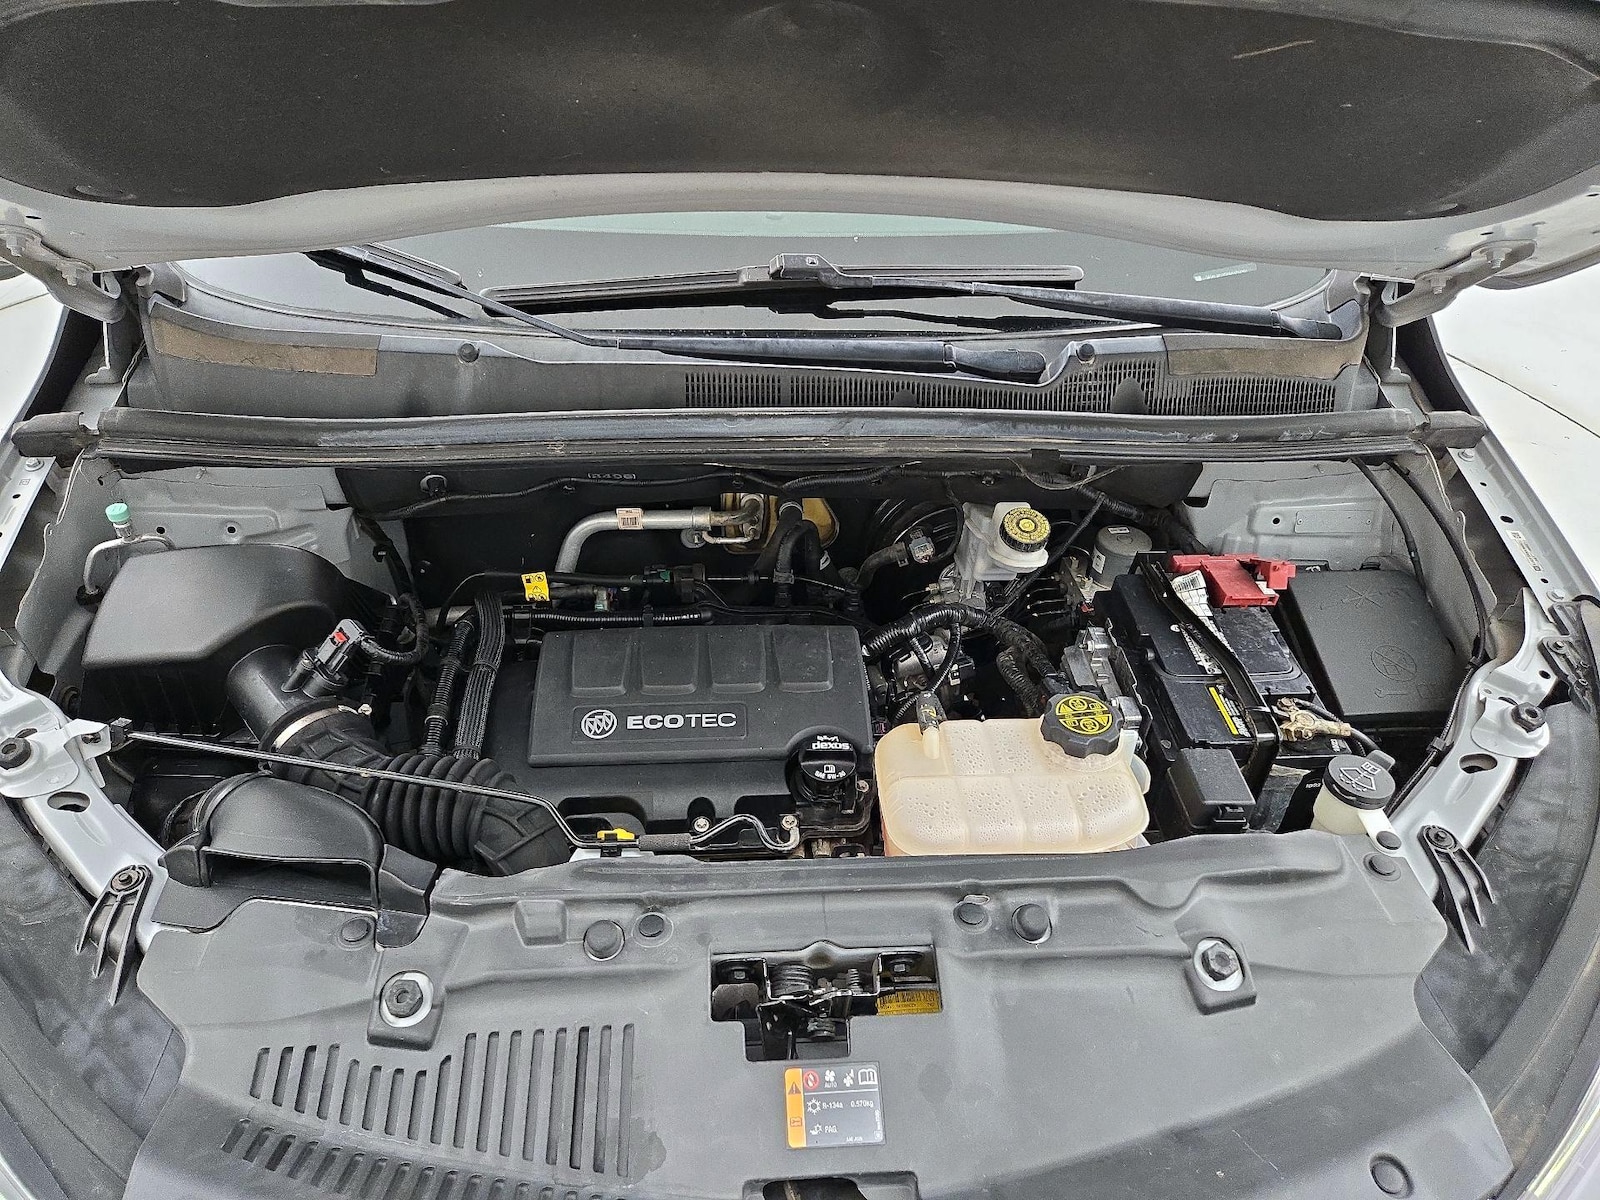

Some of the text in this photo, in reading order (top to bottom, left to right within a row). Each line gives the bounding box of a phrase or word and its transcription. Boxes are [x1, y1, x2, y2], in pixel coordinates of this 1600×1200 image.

[626, 712, 737, 730] ECOTEC
[811, 741, 850, 750] dexos
[822, 1101, 844, 1109] R-134a
